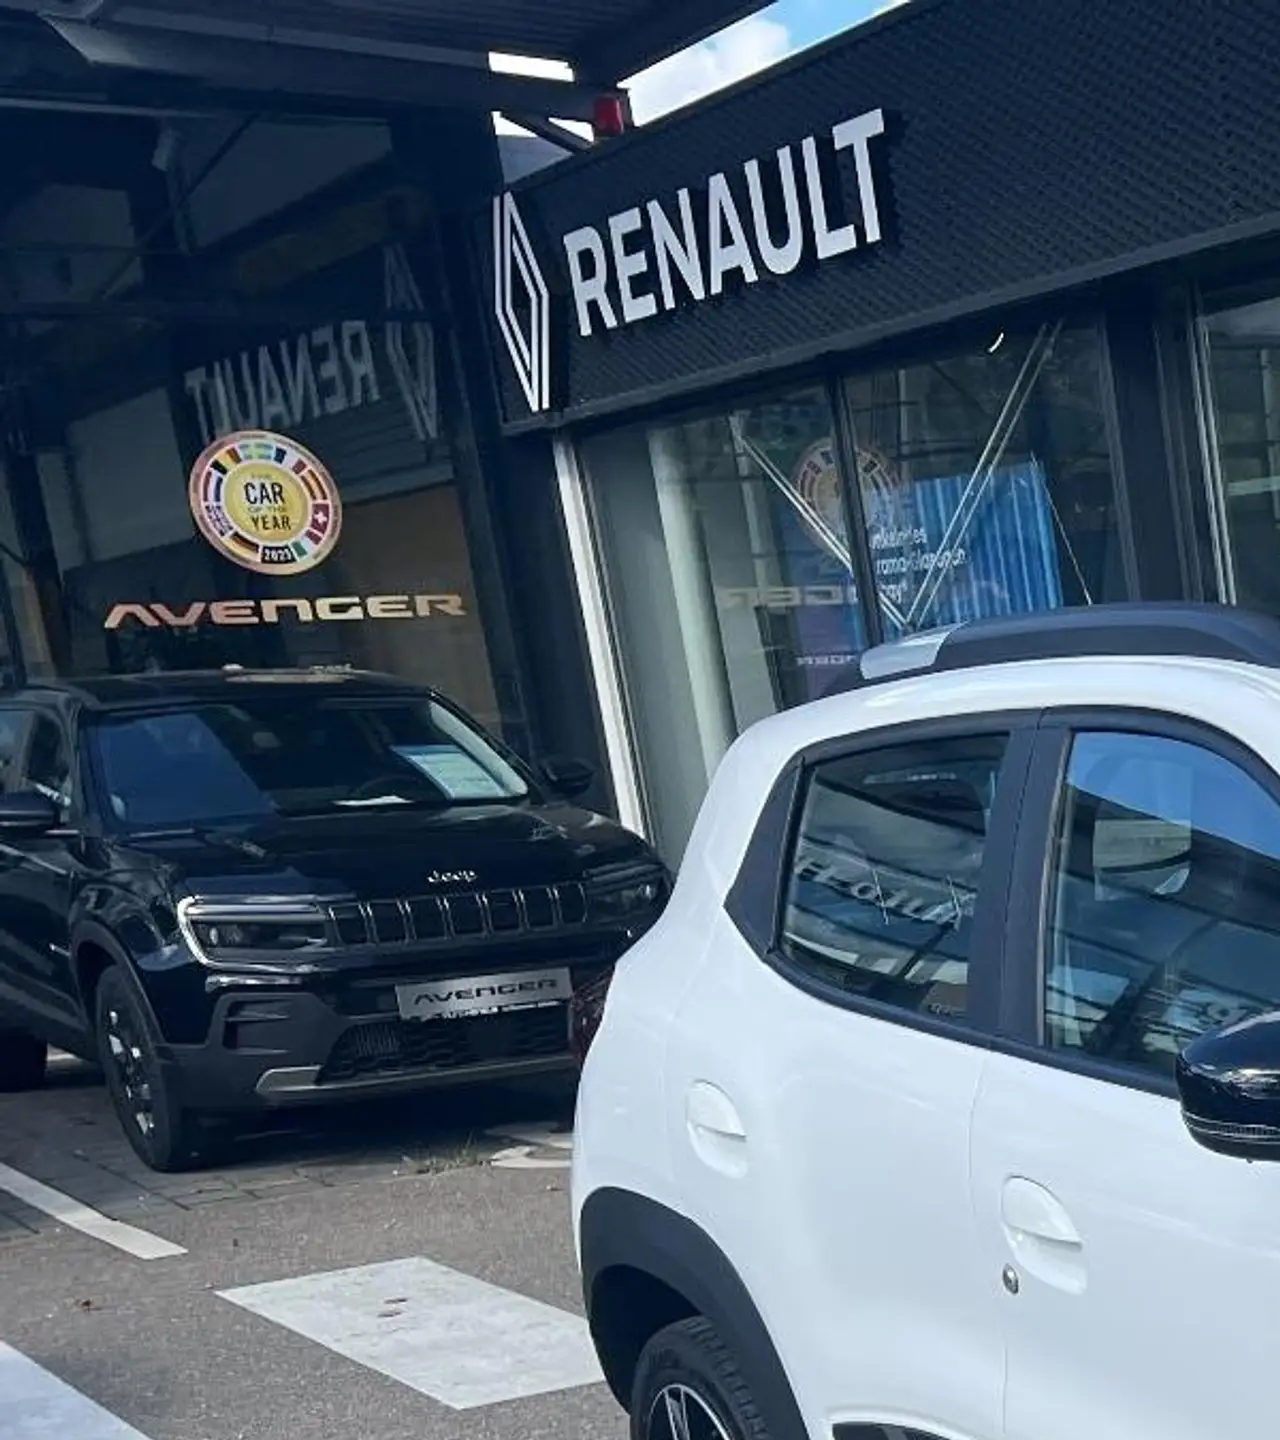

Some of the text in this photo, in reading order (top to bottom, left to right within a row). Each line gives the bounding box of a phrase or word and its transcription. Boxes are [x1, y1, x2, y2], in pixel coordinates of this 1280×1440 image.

[563, 108, 884, 337] RENAULT
[243, 482, 284, 505] CAR
[251, 513, 291, 531] YEAR
[104, 594, 467, 628] AVENGER
[414, 979, 558, 1006] AVENGER
